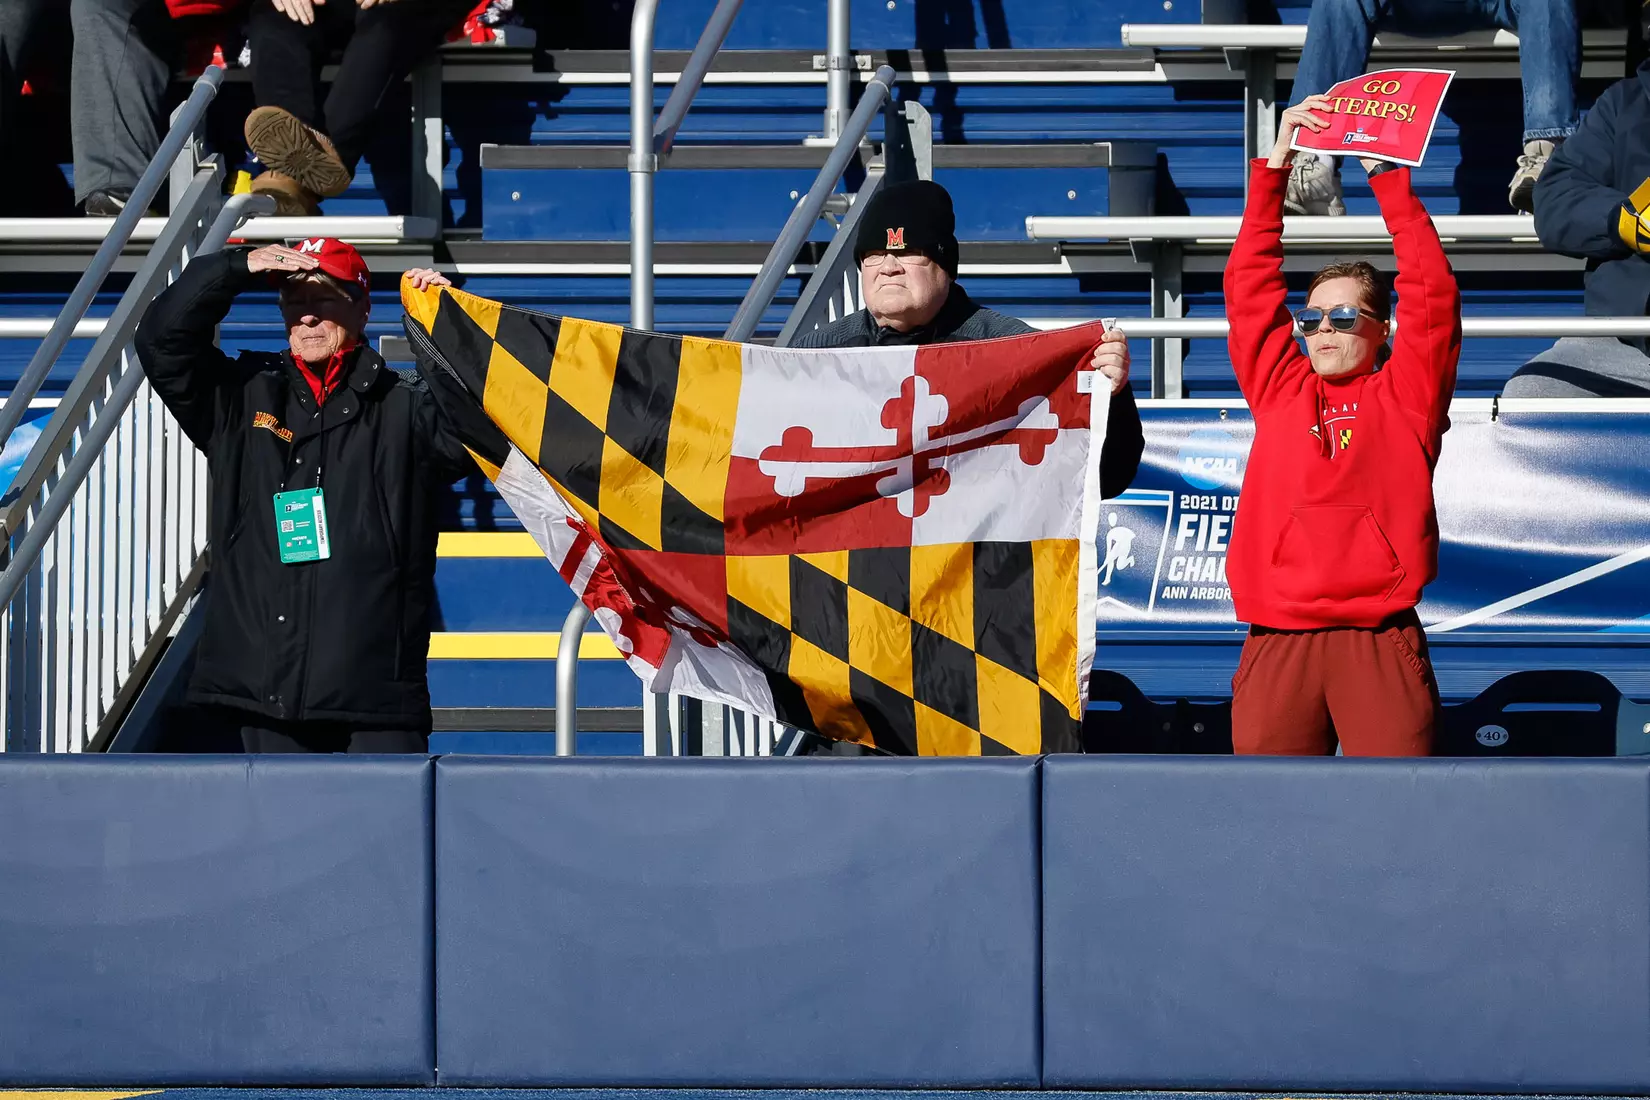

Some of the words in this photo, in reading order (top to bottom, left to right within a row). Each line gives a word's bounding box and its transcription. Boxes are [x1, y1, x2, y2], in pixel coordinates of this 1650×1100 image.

[1363, 80, 1401, 95] GO
[1332, 97, 1417, 123] TERPS!
[300, 238, 325, 253] M
[886, 227, 905, 249] M
[1183, 457, 1237, 474] NCAA
[1180, 495, 1217, 511] 2021
[1221, 495, 1240, 511] DI
[1174, 514, 1235, 551] FIE
[1161, 586, 1189, 600] ANN
[1483, 731, 1501, 741] 40
